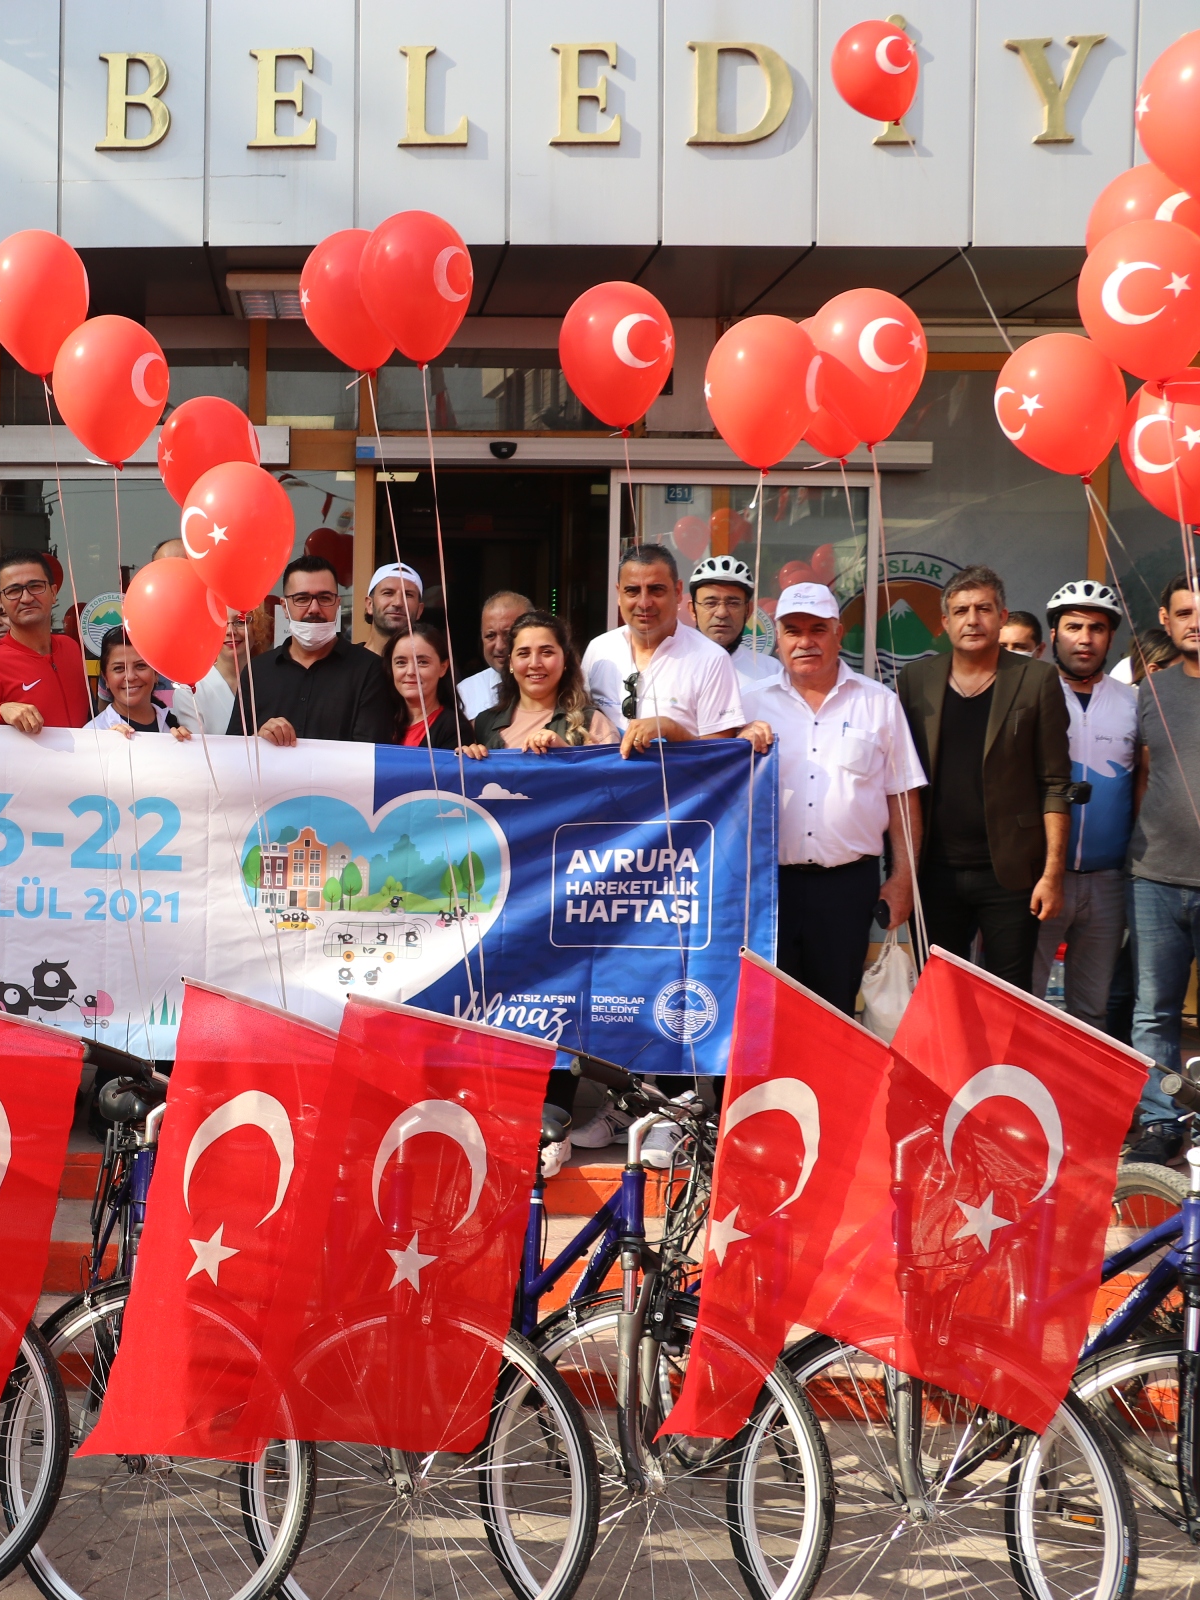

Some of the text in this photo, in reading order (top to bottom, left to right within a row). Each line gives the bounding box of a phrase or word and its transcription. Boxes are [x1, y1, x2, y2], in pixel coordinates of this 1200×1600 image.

[94, 13, 1108, 151] BELEDY
[669, 487, 690, 499] 251
[565, 848, 700, 874] AVRUPA
[565, 876, 699, 896] HAREKETLİLİK
[83, 887, 180, 924] 2021
[565, 899, 700, 925] HAFTASI
[509, 994, 576, 1006] ATSIZ AFŞIN
[591, 995, 645, 1005] TOROSLAR
[591, 1004, 640, 1015] BELEDİYE
[591, 1014, 634, 1025] BAŞKANI
